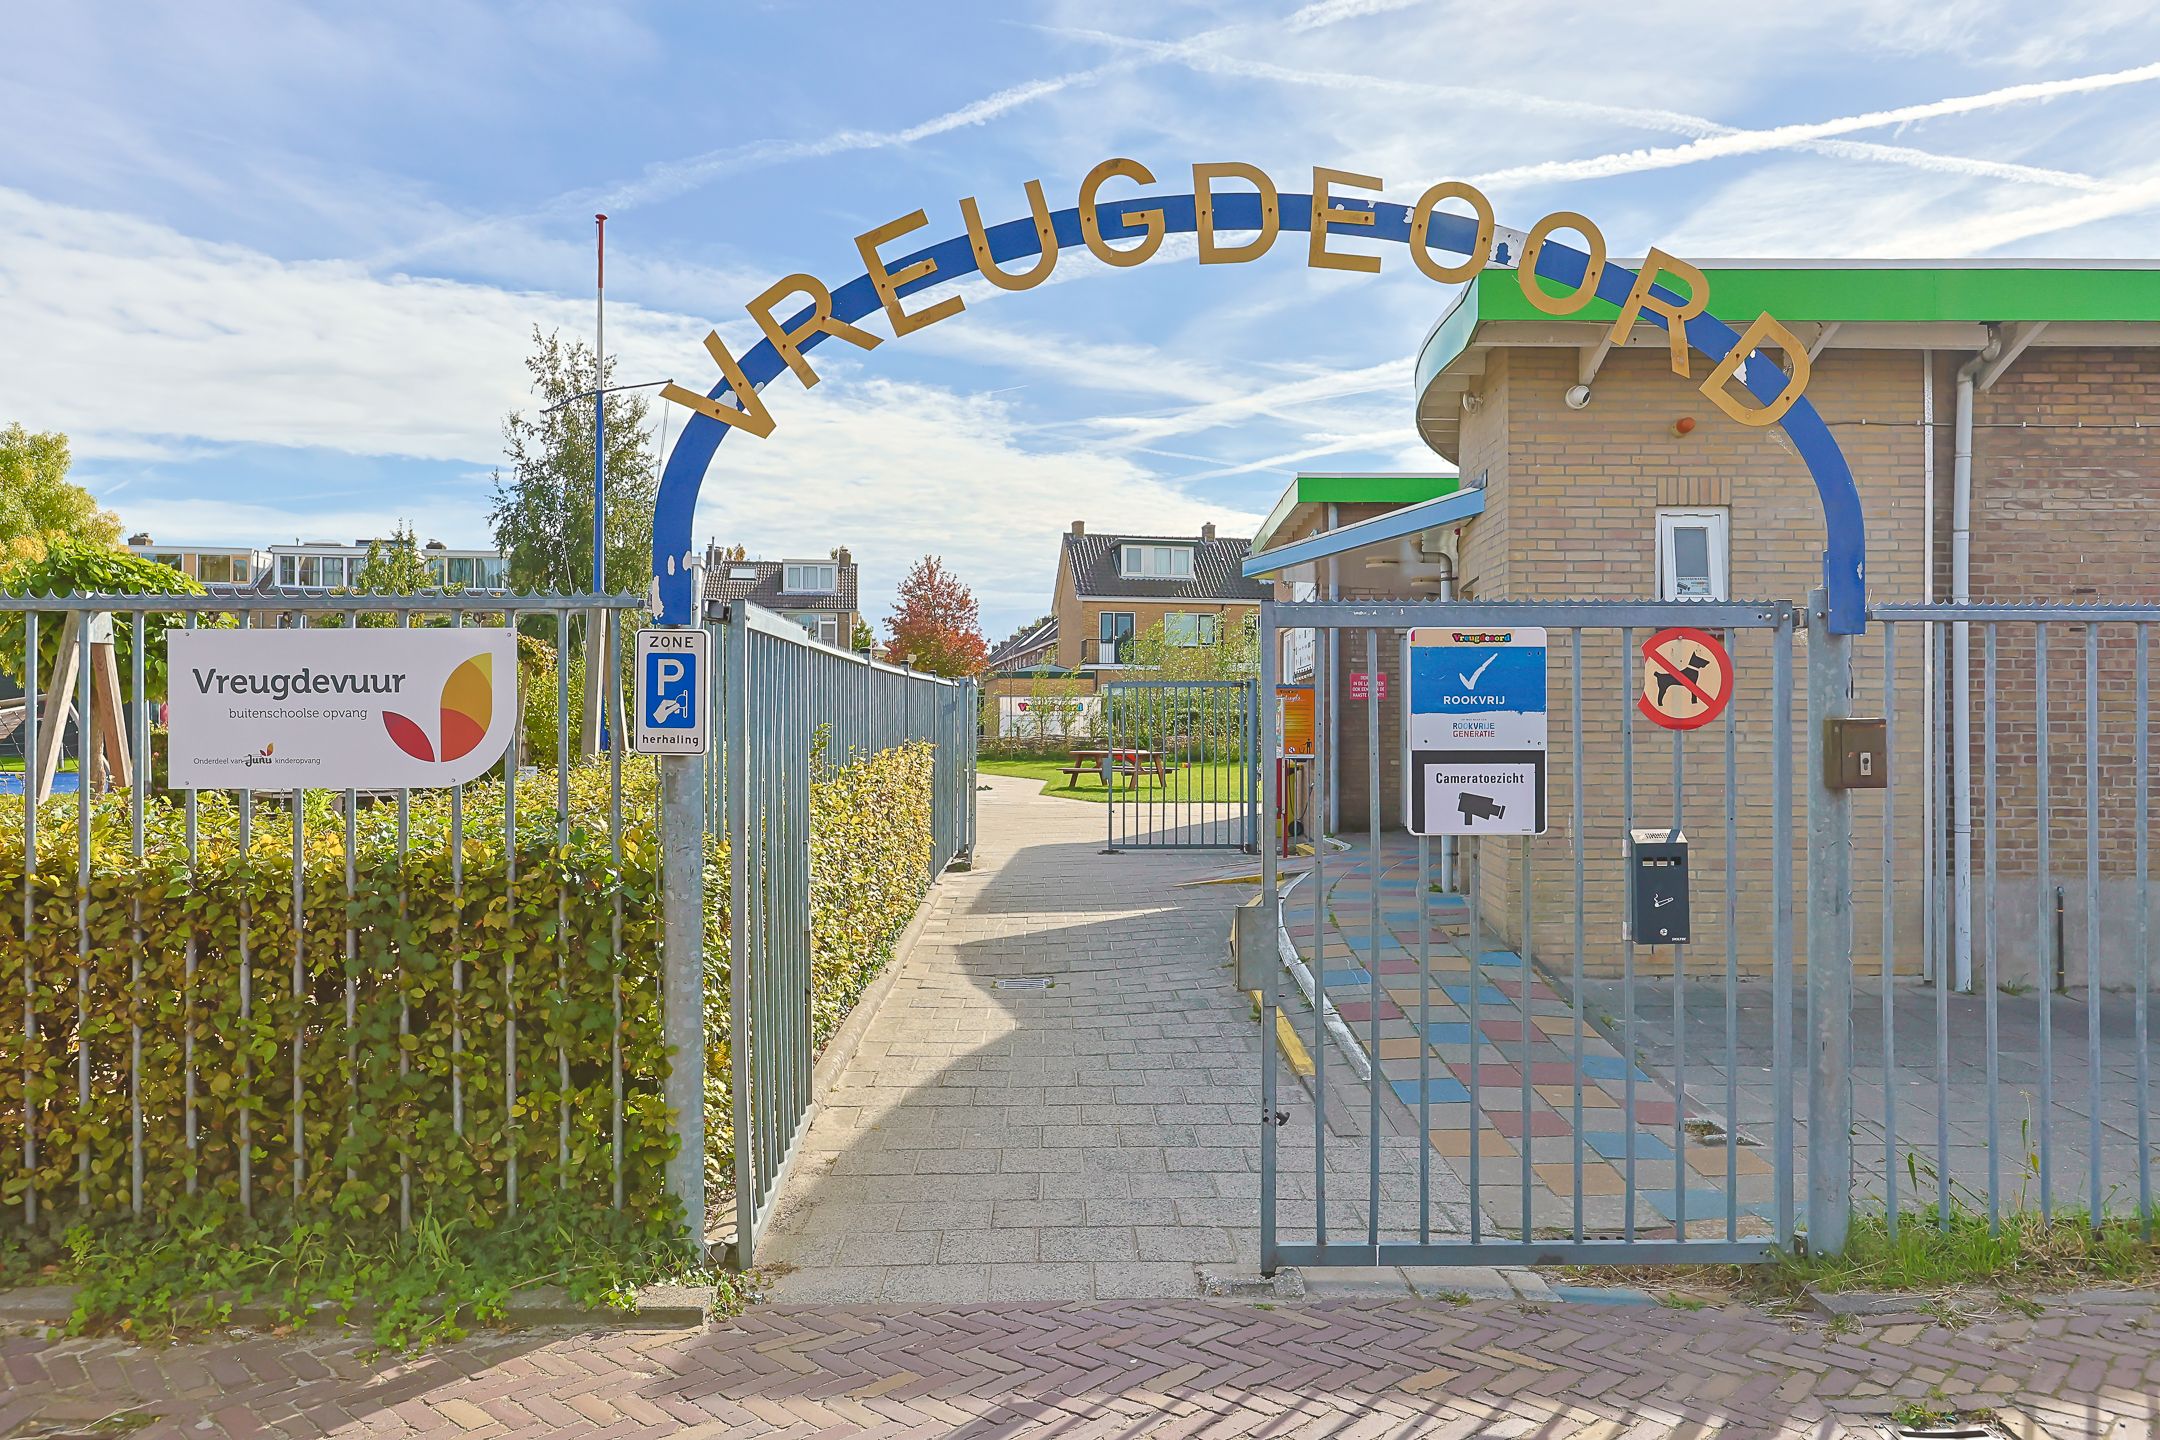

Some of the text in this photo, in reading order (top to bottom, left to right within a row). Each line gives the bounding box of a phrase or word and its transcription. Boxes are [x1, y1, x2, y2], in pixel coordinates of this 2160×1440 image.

[659, 157, 1811, 438] VREUGDEOORD
[649, 636, 694, 648] ZONE
[1452, 633, 1512, 644] Vreugdeoord
[657, 658, 685, 696] P
[192, 668, 406, 701] Vreugdevuur
[1443, 695, 1505, 705] ROOKVRIJ
[229, 707, 368, 721] buitenschoolse opvang
[1452, 722, 1495, 730] ROOKVRIJE
[1452, 730, 1495, 738] GENERATIE
[642, 734, 699, 747] herhaling
[193, 757, 229, 765] Onderdeel
[275, 757, 321, 766] kinderopvang
[1435, 772, 1525, 784] Cameratoezicht
